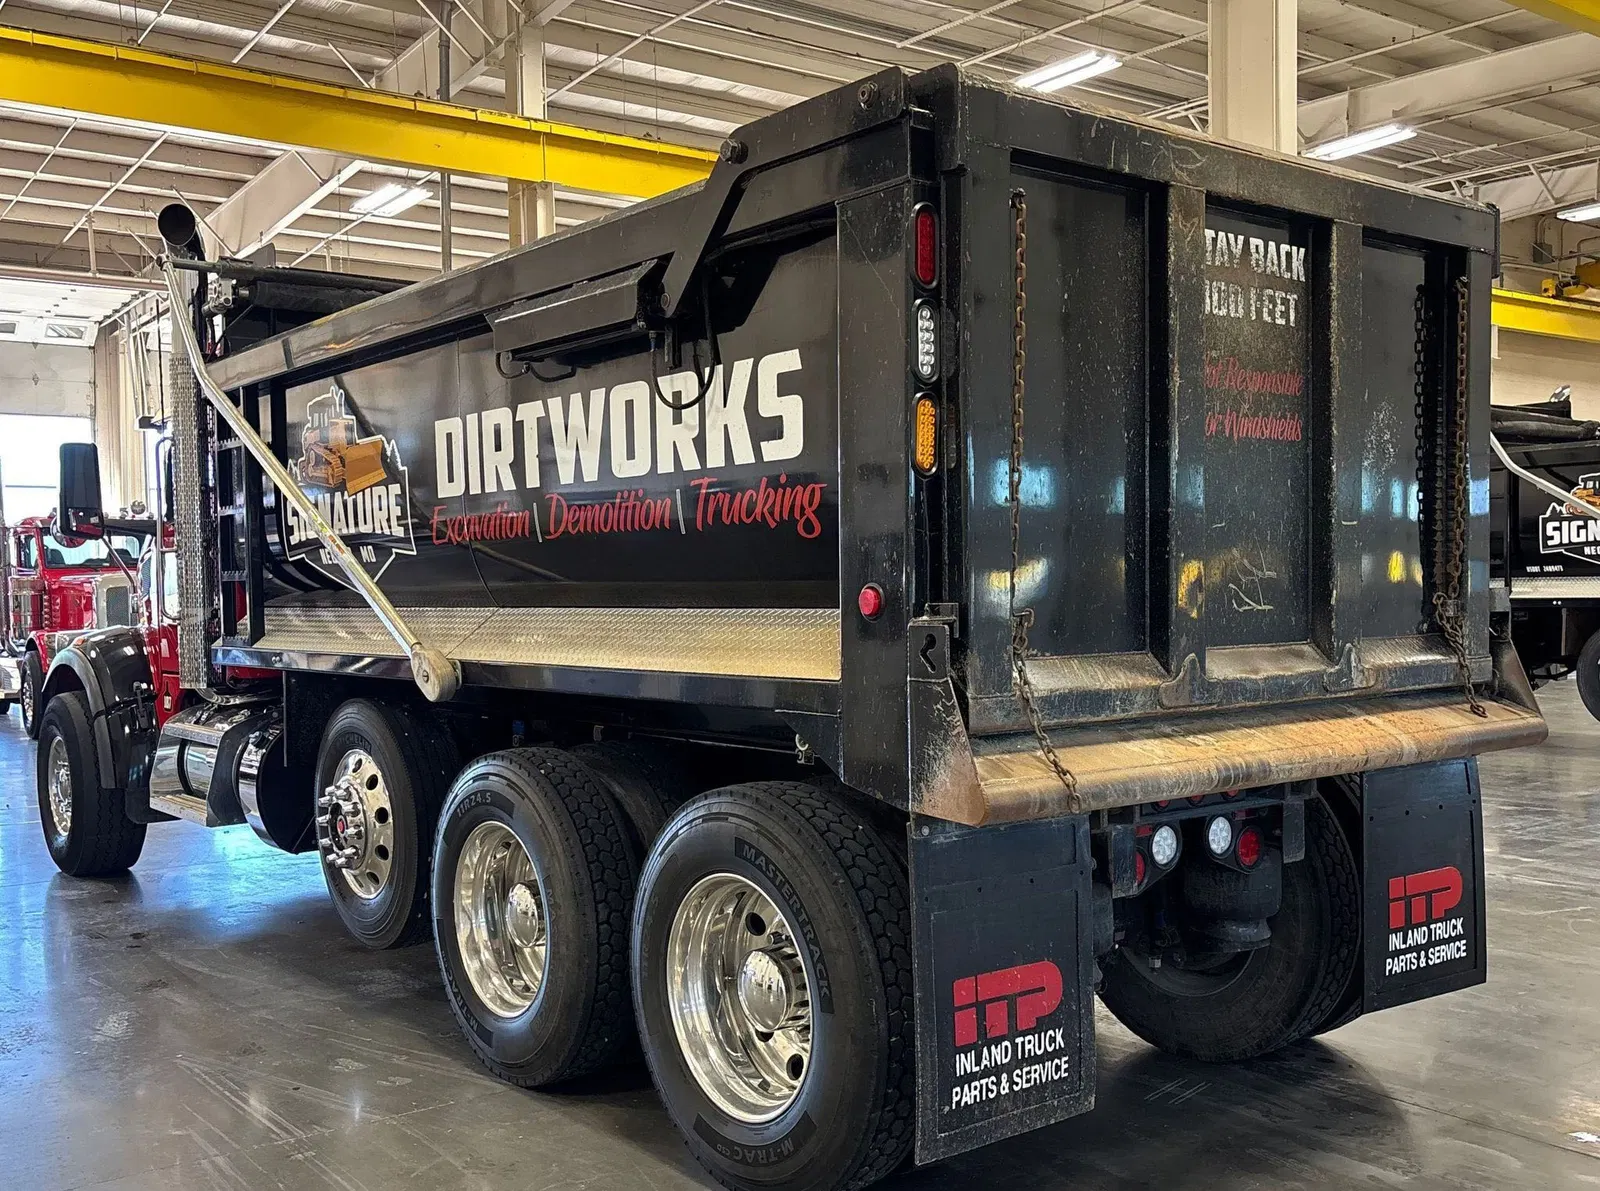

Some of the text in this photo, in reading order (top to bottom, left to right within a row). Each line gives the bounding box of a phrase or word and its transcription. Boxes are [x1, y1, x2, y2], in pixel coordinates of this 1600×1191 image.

[1205, 228, 1306, 282] TAY BACK
[1249, 286, 1298, 327] FEET
[434, 348, 804, 499] DIRTWORKS
[429, 473, 827, 545] Excavation Demolition Trucking
[360, 545, 377, 563] MO
[1546, 519, 1600, 546] SIGN
[456, 792, 492, 818] 11R24.5
[743, 844, 832, 1000] MASTERTRACK
[1388, 917, 1464, 952] INLAND TRUCK
[1385, 939, 1467, 976] PARTS & SERVICE
[955, 1027, 1065, 1077] INLAND TRUCK
[952, 1056, 1069, 1110] PARTS & SERVICE
